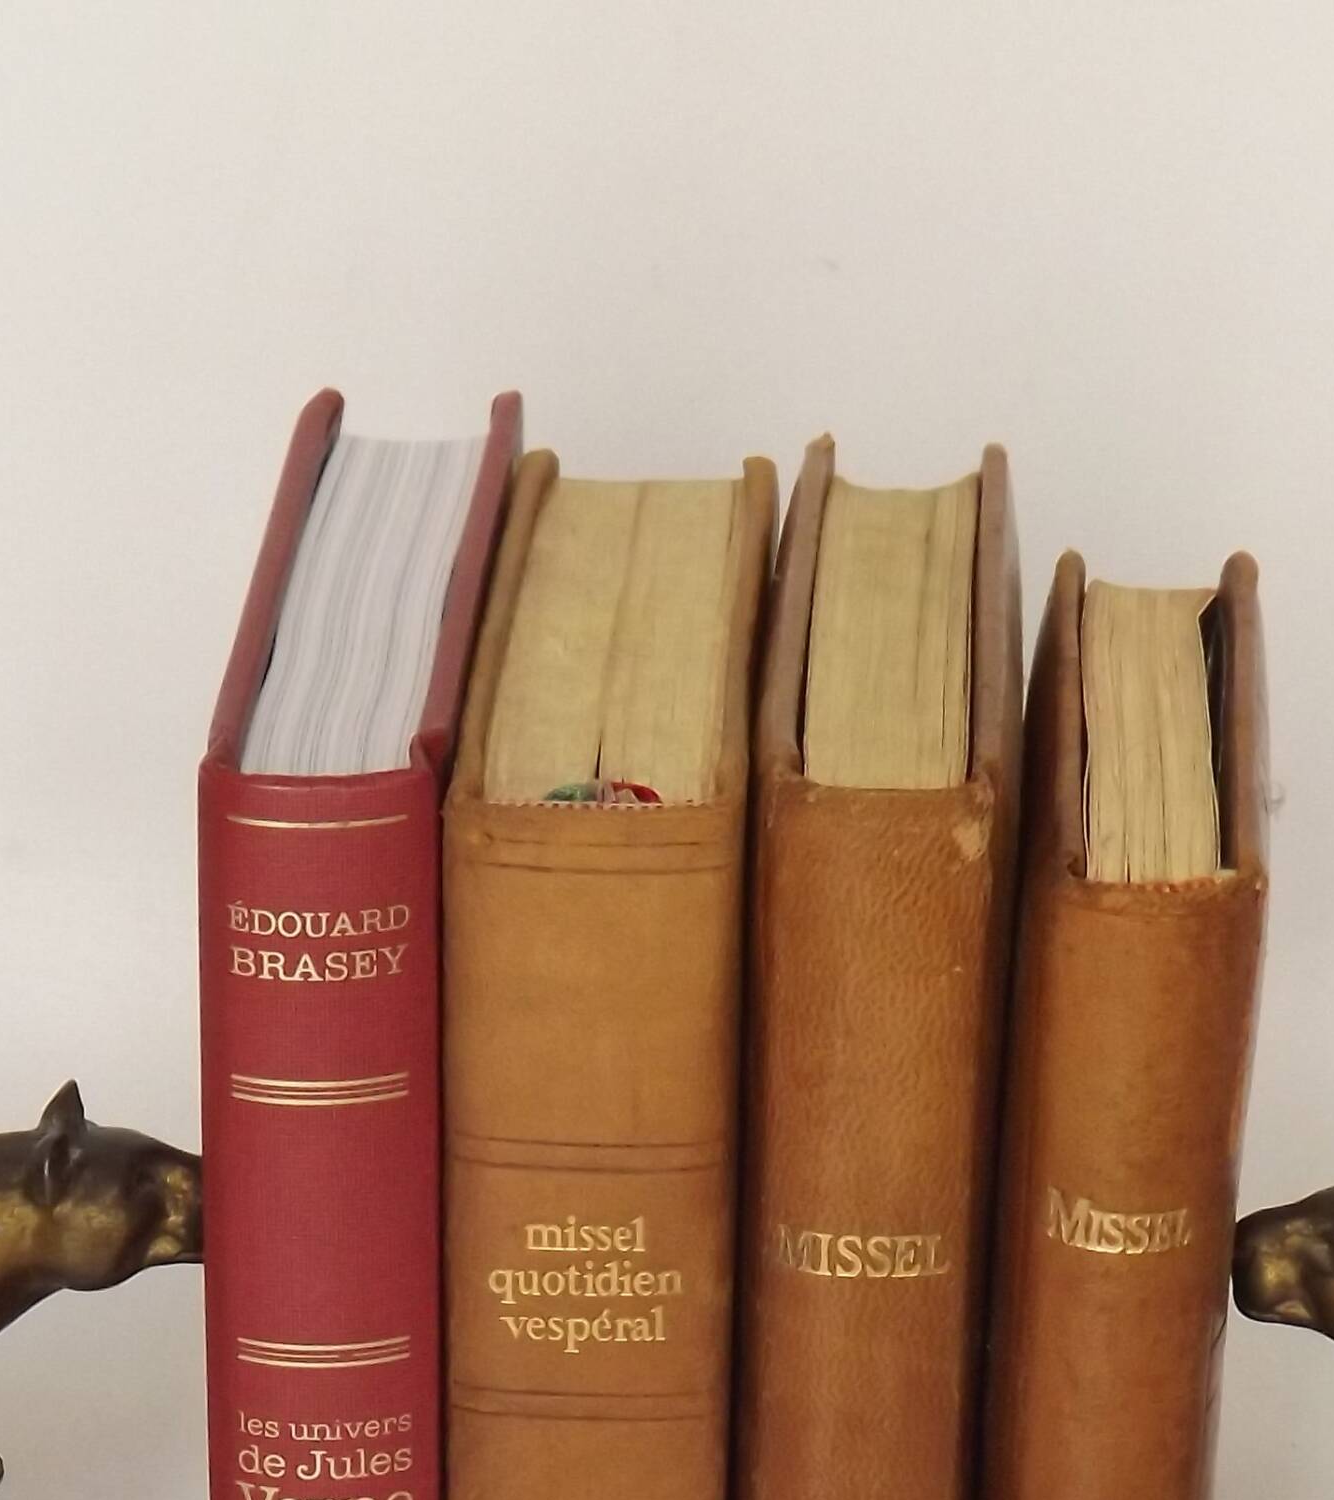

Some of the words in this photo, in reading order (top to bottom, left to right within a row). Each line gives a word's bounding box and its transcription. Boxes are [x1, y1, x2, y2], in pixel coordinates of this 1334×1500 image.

[227, 900, 410, 938] ÉDOUARD
[229, 944, 409, 981] BRASEY
[524, 1214, 646, 1252] missel
[777, 1223, 950, 1278] MISSEL
[488, 1260, 683, 1304] quotidien
[499, 1305, 666, 1353] vespéral
[238, 1410, 280, 1438] les
[288, 1413, 412, 1441] univers
[238, 1444, 286, 1478] de
[296, 1447, 413, 1480] Jules
